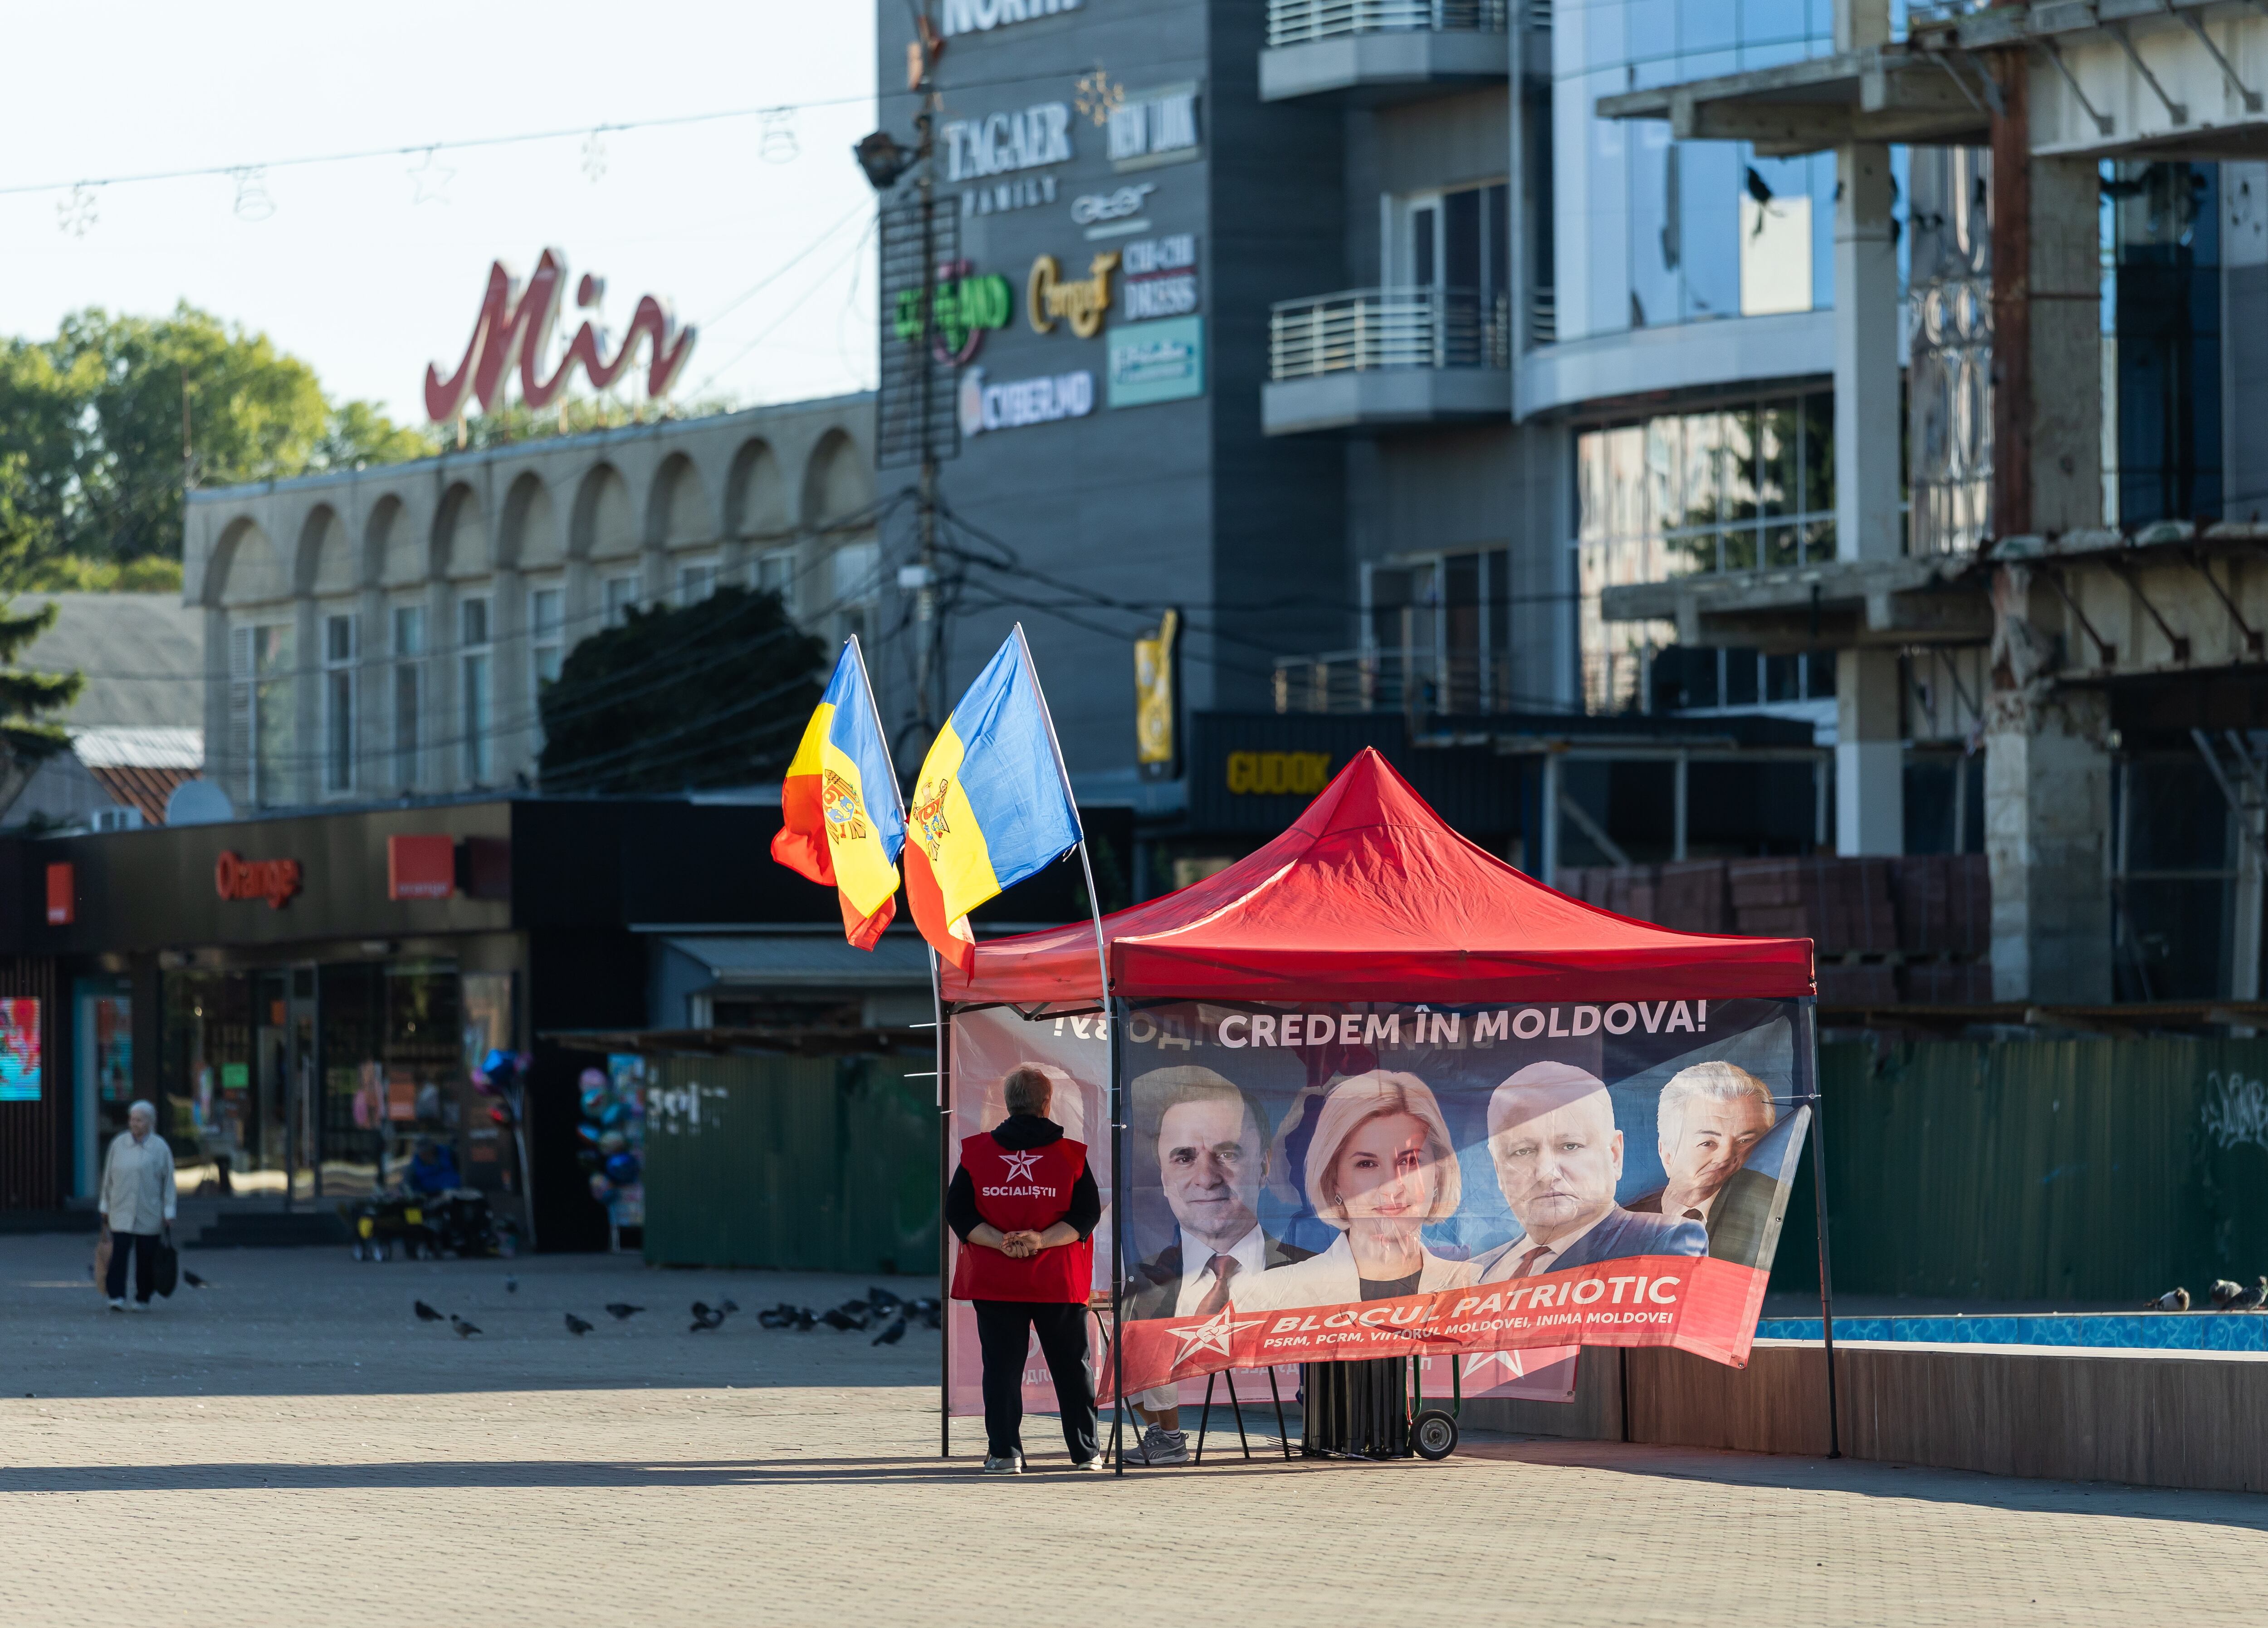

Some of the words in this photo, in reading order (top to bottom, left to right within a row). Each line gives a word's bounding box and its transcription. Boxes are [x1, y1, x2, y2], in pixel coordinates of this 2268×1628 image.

[425, 247, 695, 423] Mir
[1218, 1014, 1399, 1048] CREDEM
[1414, 1005, 1460, 1043] ÎN
[1473, 1000, 1707, 1042] MOLDOVA!
[982, 1186, 1056, 1199] SOCIALIȘTII
[1271, 1304, 1440, 1334] BLOCUL
[1451, 1276, 1681, 1318] PATRIOTIC
[1264, 1336, 1310, 1348] PSRM,
[1315, 1333, 1364, 1344] PCRM,
[1371, 1327, 1441, 1341] VIITORUL
[1444, 1316, 1532, 1334] MOLDOVEI,
[1536, 1313, 1581, 1326] INIMA
[1586, 1312, 1673, 1324] MOLDOVEI
